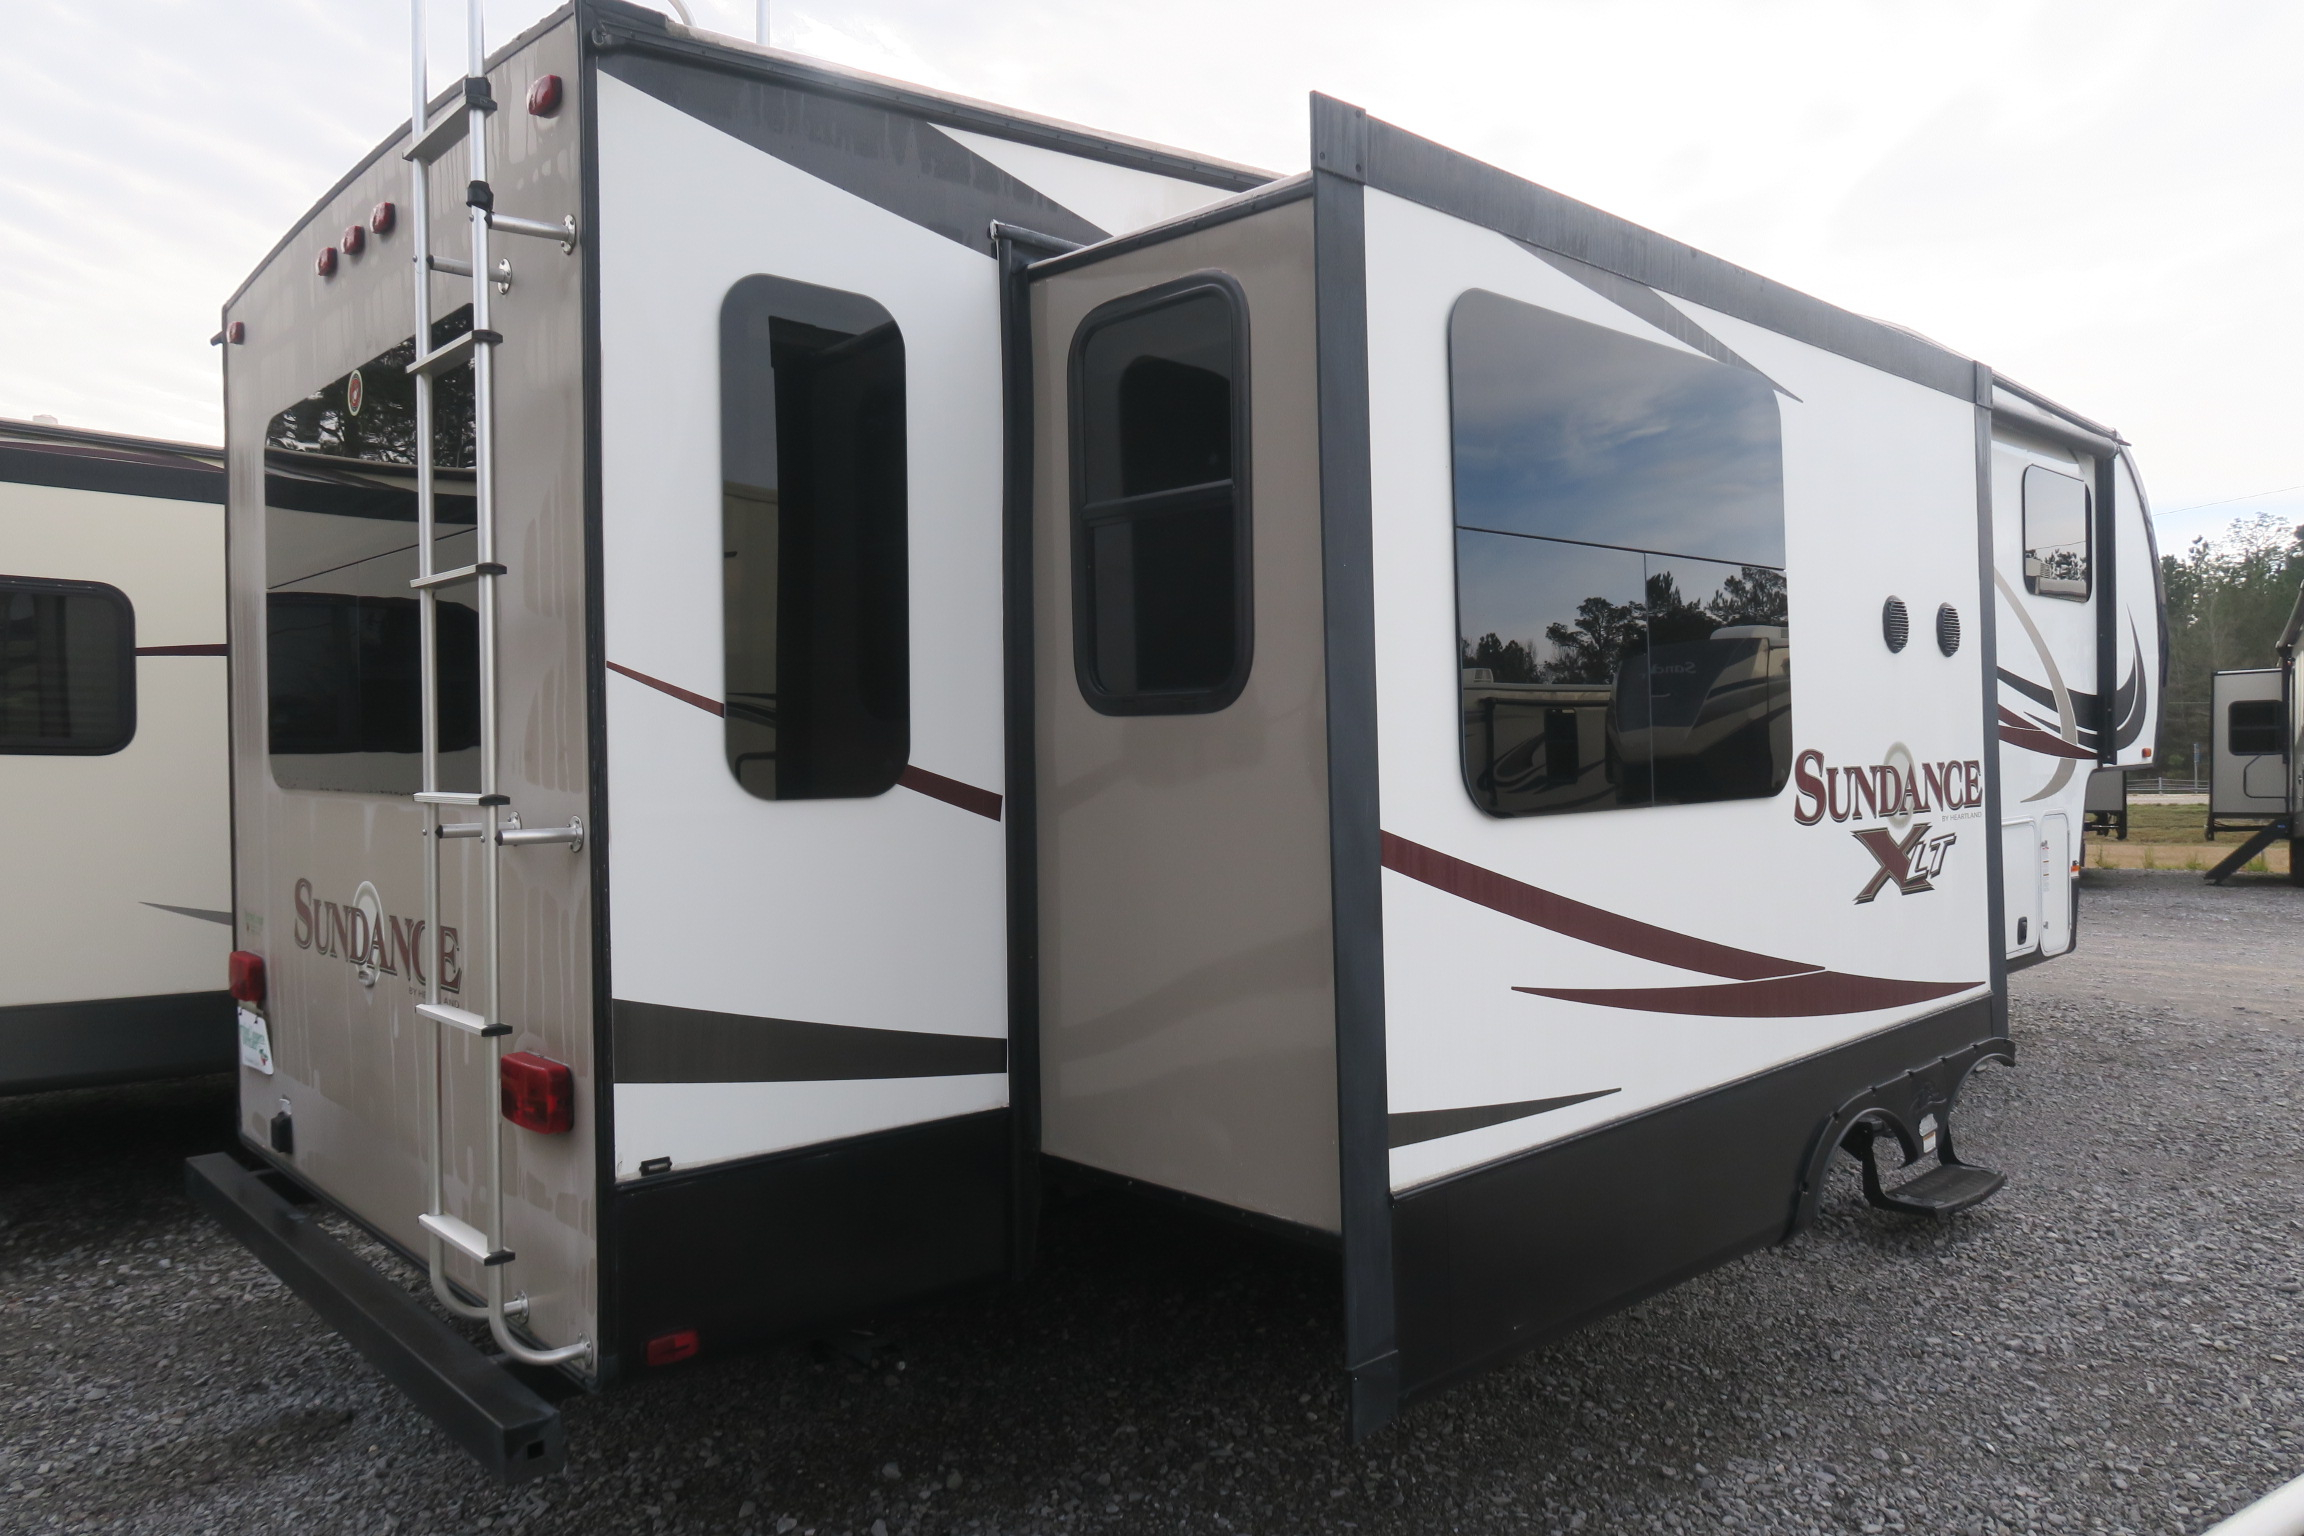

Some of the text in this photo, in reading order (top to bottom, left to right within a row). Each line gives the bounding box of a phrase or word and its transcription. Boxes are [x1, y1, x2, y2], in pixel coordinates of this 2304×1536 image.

[1794, 748, 1983, 826] SUNDANCE
[1941, 811, 1982, 823] BY HEARTLAND
[1850, 822, 1957, 905] XLT
